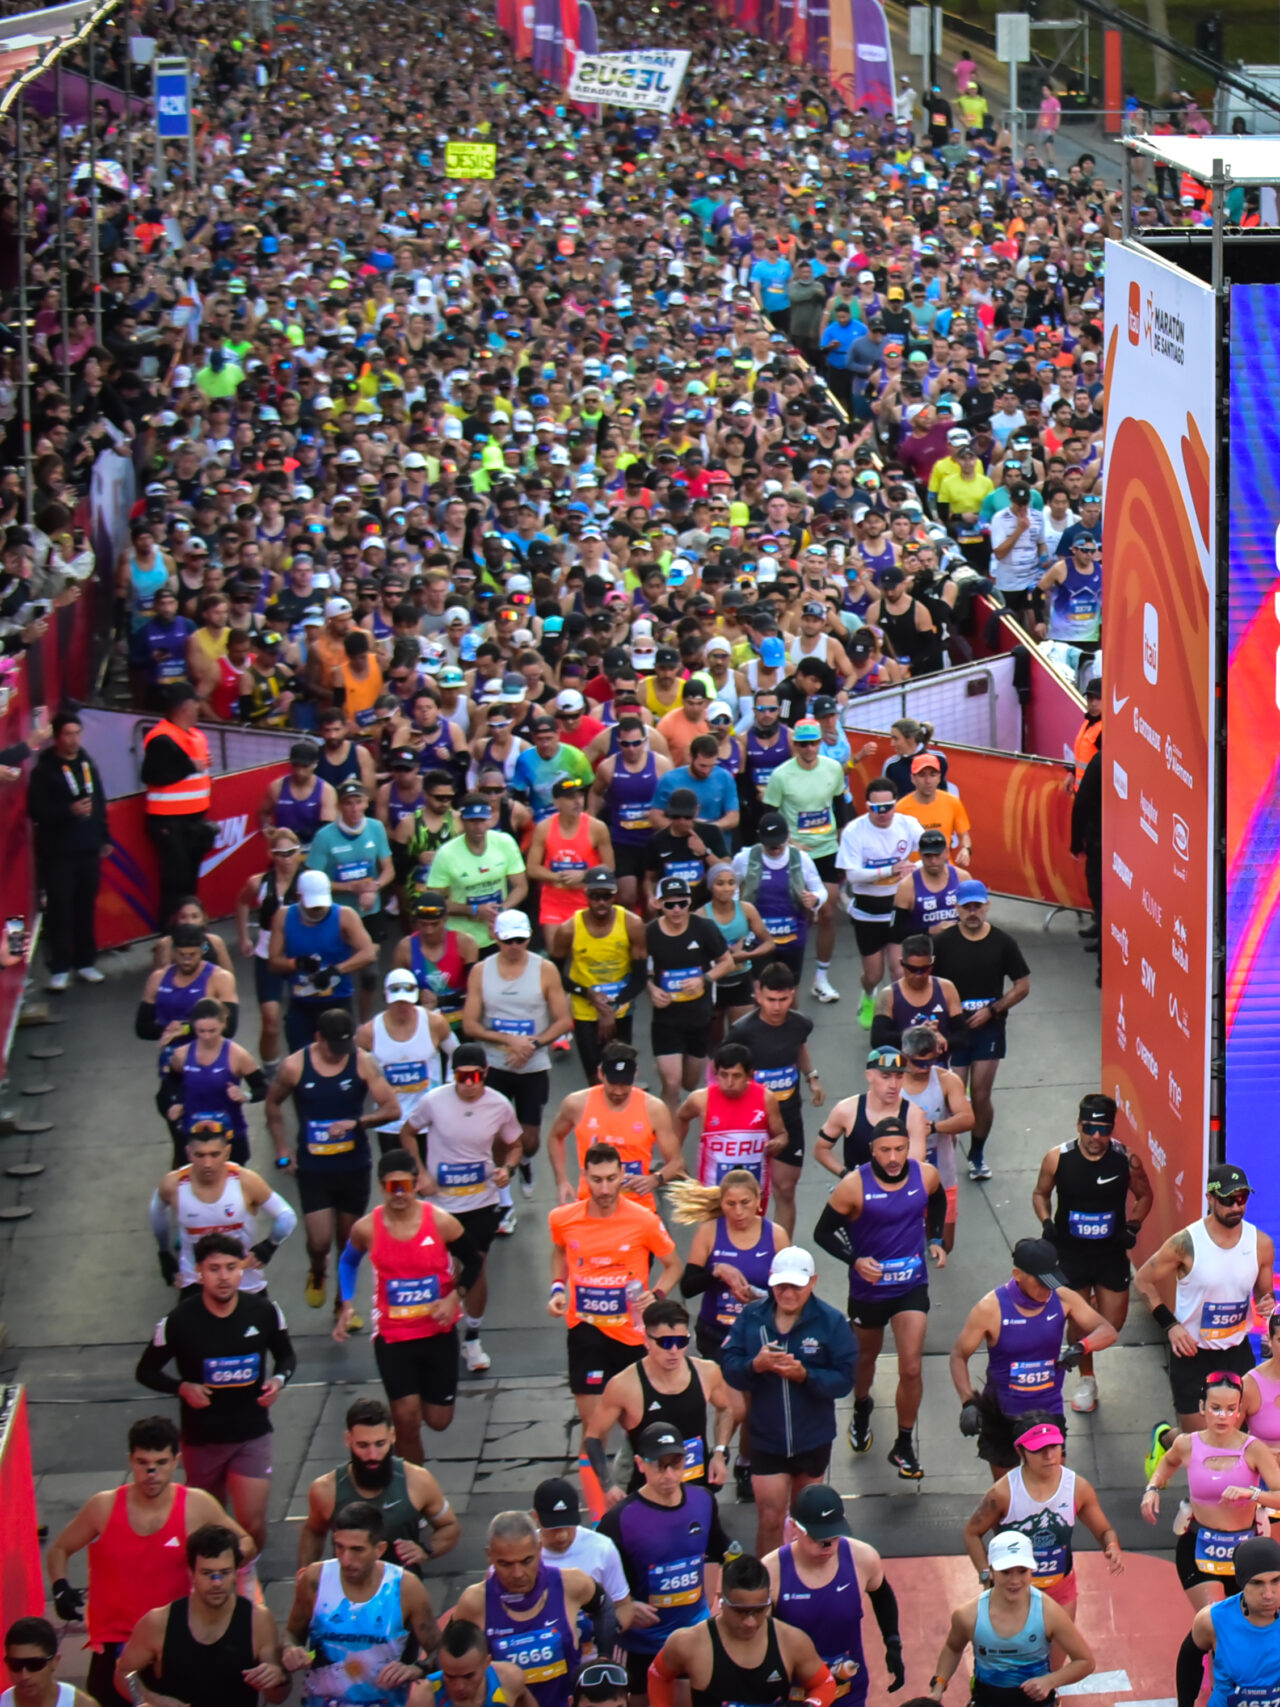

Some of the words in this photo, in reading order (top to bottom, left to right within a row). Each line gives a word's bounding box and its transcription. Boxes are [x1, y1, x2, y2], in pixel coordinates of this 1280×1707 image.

[1154, 307, 1185, 346] MARATÓN
[711, 1140, 766, 1157] PERU
[1077, 1223, 1108, 1236] 1996
[583, 1299, 619, 1312] 2606
[1018, 1370, 1050, 1384] 3613
[660, 1572, 699, 1591] 2685
